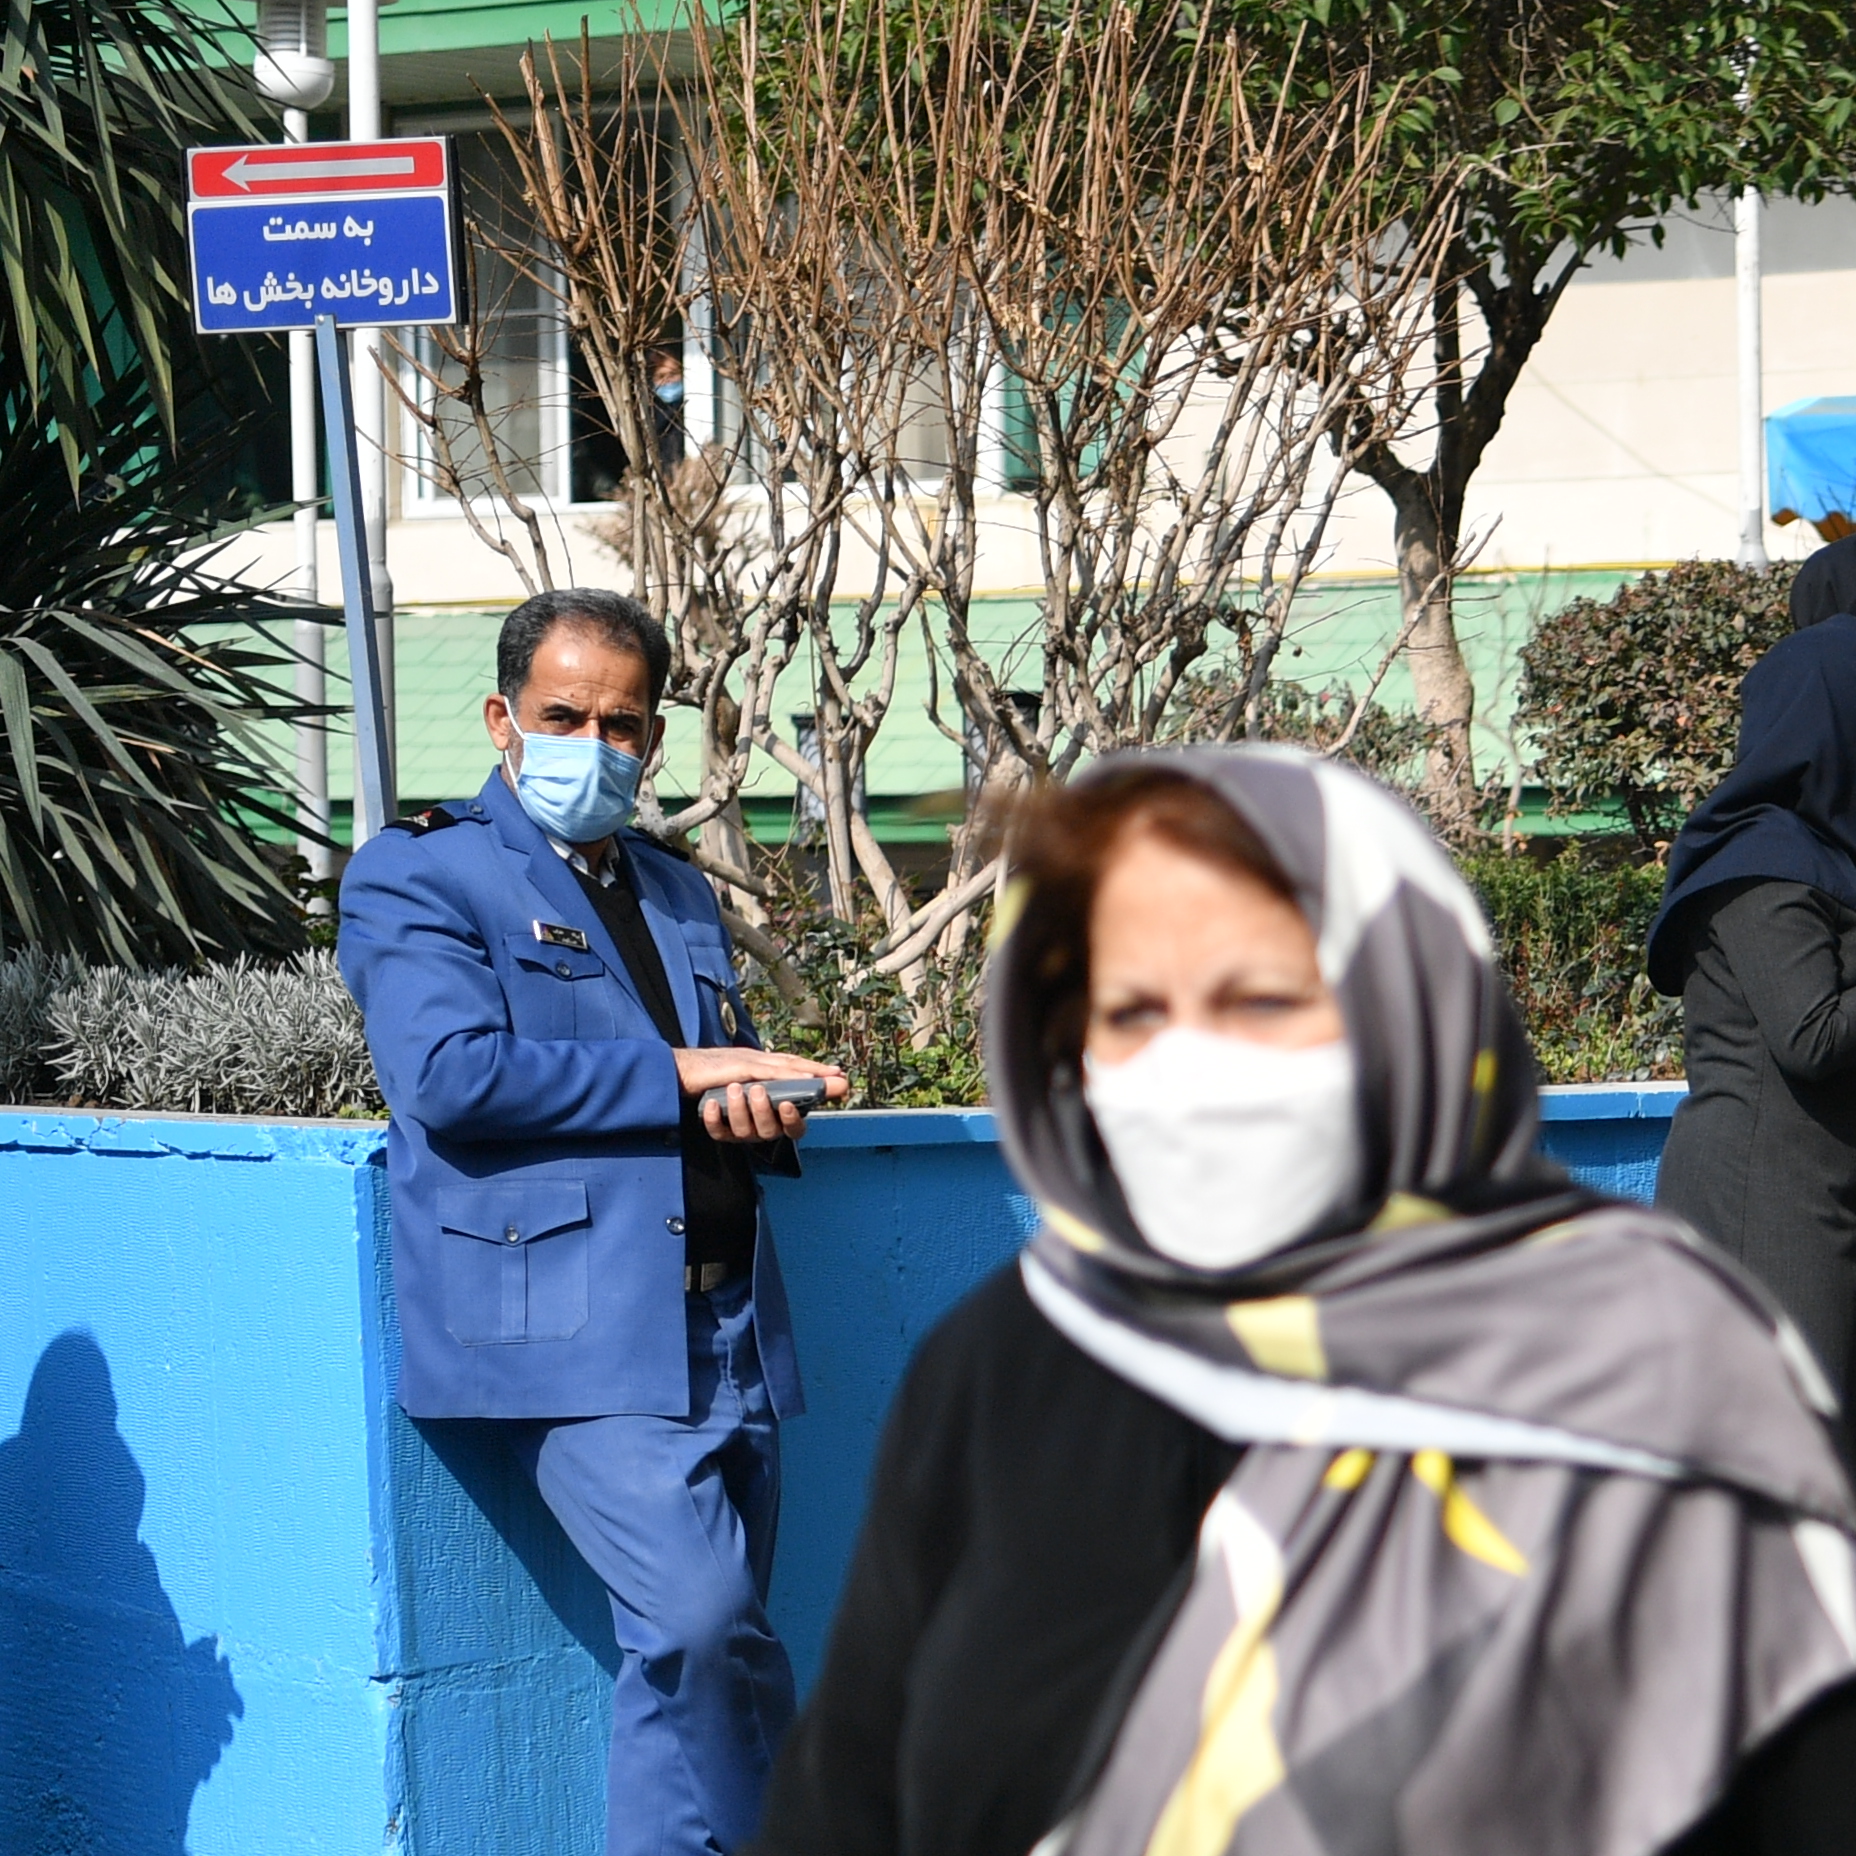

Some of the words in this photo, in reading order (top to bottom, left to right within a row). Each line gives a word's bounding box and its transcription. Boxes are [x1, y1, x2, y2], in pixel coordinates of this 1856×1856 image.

[263, 216, 338, 242] سمت
[343, 215, 374, 246] به
[206, 276, 238, 305] ها
[243, 271, 315, 312] بخش
[320, 267, 440, 306] داروخانه
